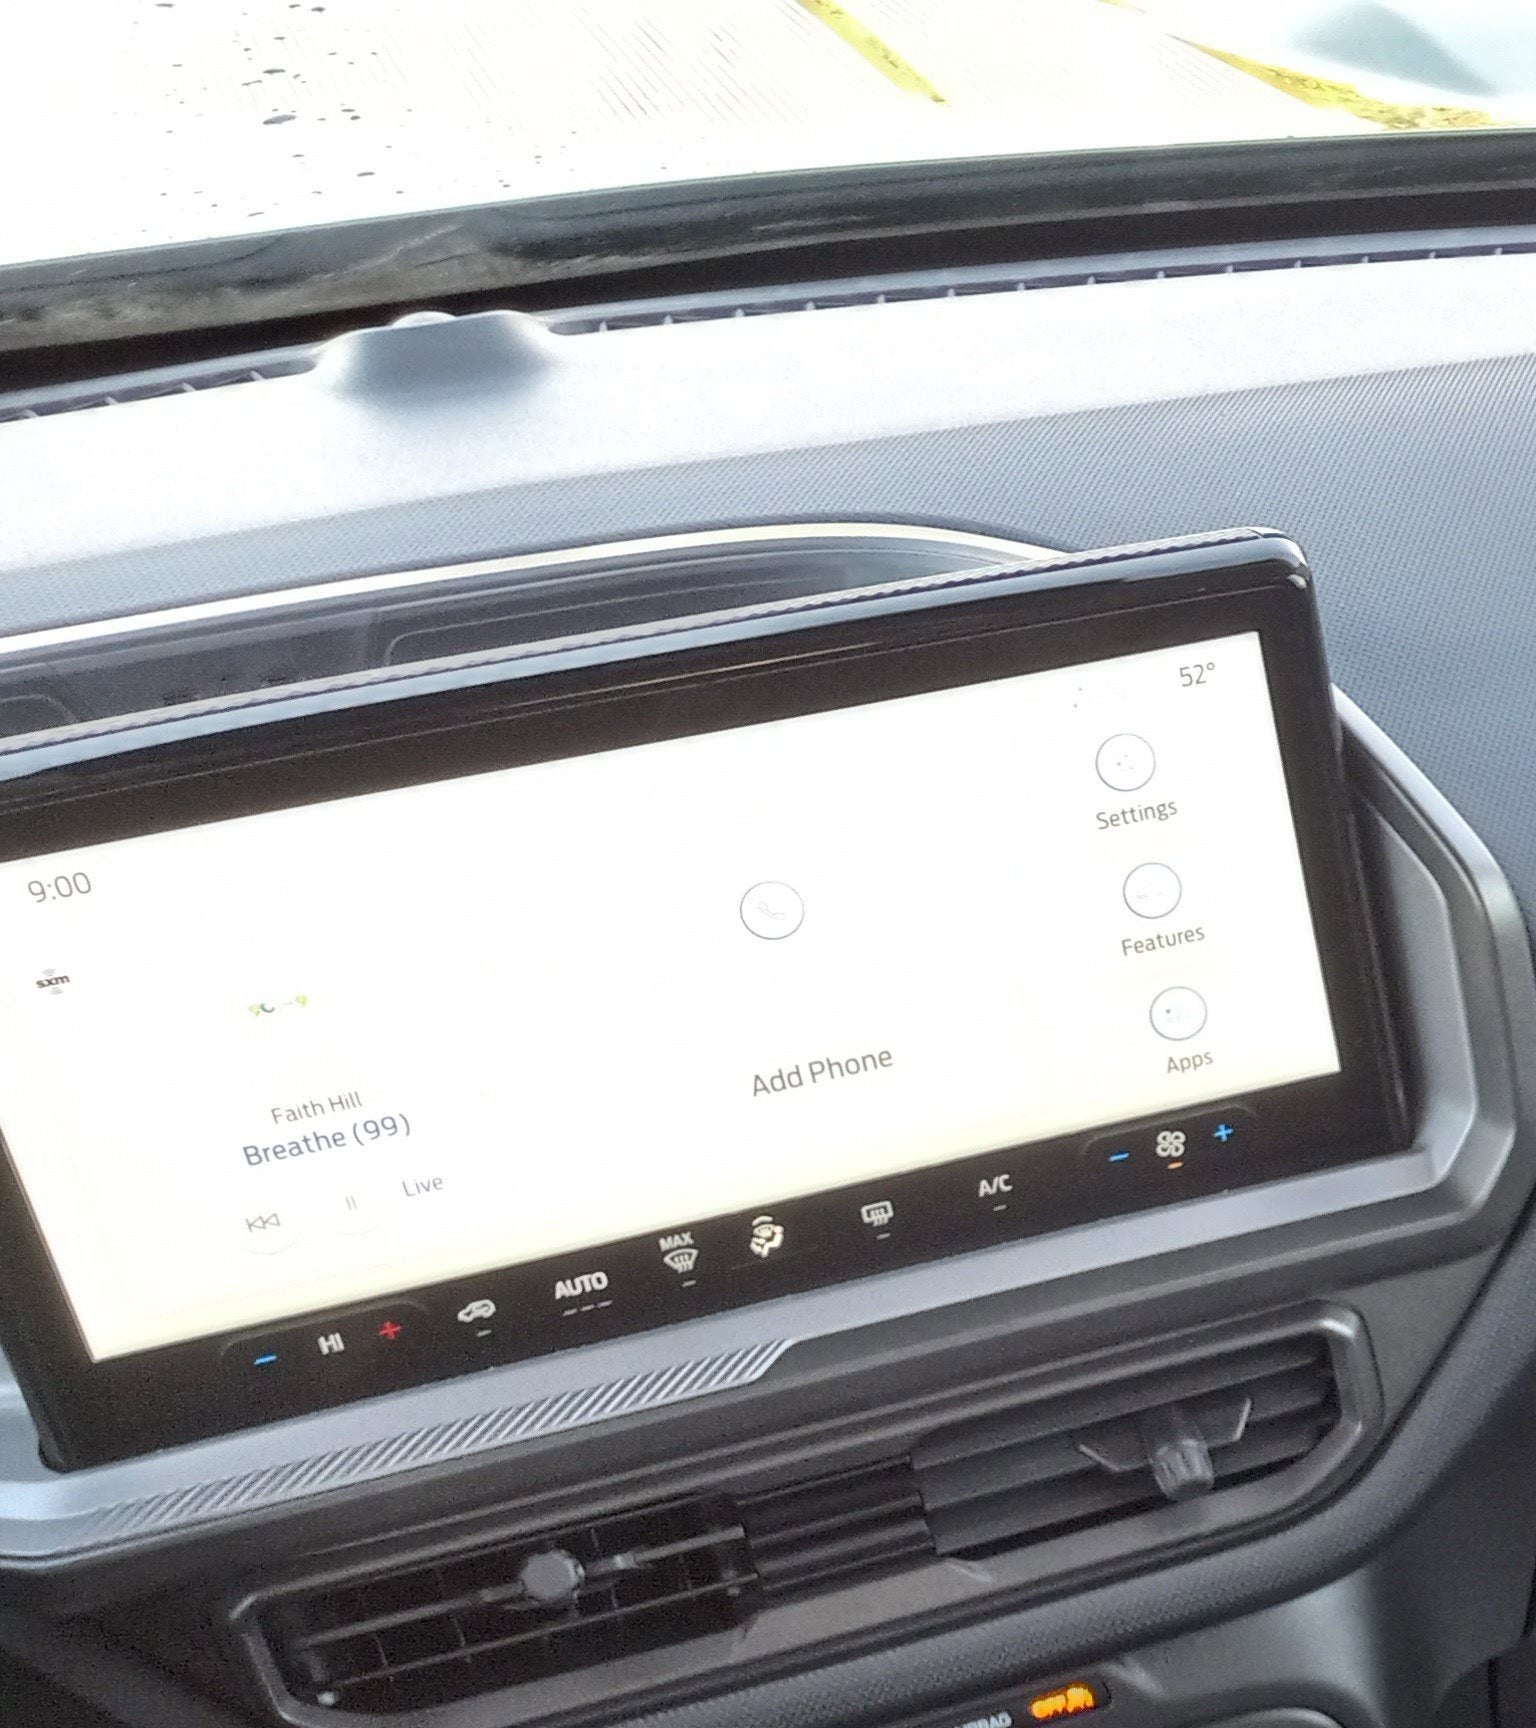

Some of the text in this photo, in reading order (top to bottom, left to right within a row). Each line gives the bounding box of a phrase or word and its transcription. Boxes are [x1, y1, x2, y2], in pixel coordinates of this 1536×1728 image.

[1179, 661, 1217, 688] 52°
[1096, 799, 1179, 830] Settings
[28, 871, 93, 903] 9:00
[1121, 924, 1206, 957] Features
[751, 1046, 894, 1098] Add Phone
[1166, 1048, 1214, 1075] Apps
[270, 1090, 363, 1126] Faith Hill
[242, 1111, 413, 1169] Breathe (99)
[401, 1172, 444, 1199] Live
[978, 1173, 1013, 1198] A/C
[658, 1231, 695, 1252] MAX
[554, 1271, 609, 1300] AUTO
[318, 1330, 345, 1356] HI
